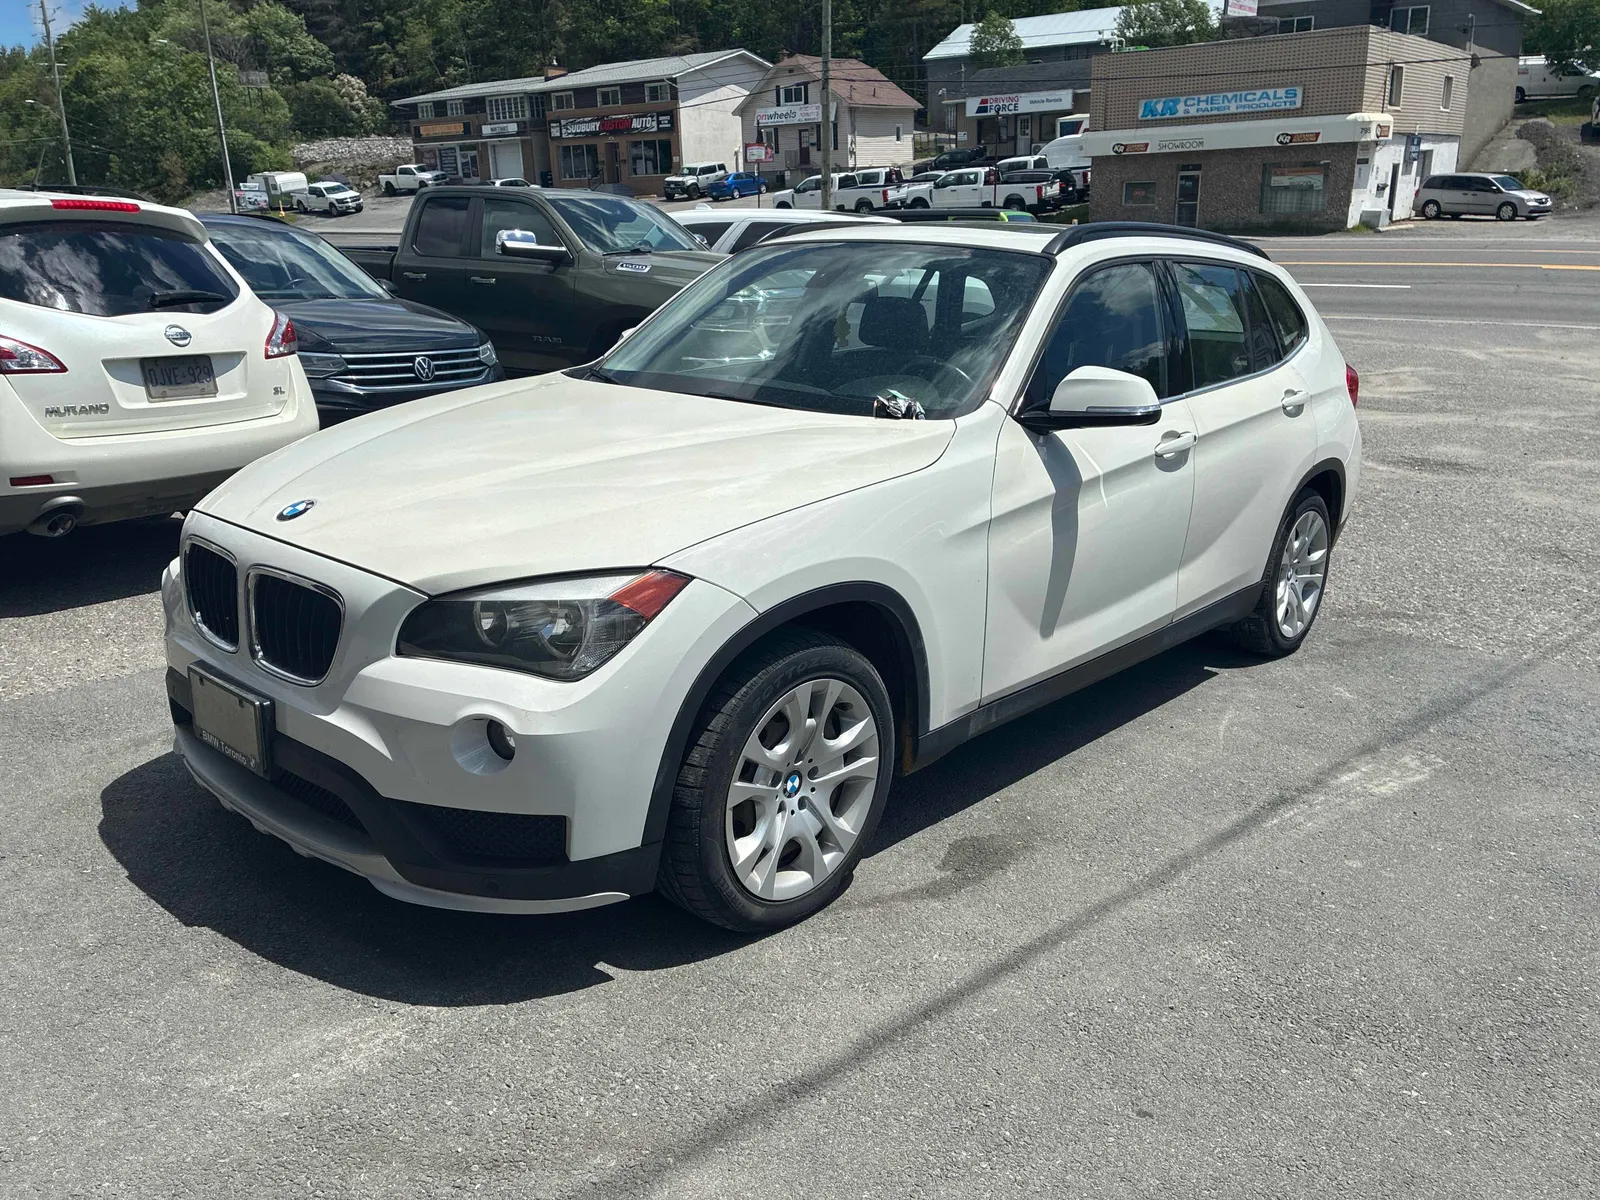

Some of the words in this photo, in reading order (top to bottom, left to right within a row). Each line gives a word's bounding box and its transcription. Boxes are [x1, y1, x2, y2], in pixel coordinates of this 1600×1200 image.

[989, 96, 1019, 104] DRIVING
[1140, 99, 1179, 118] KR
[1184, 88, 1298, 107] CHEMICALS
[989, 103, 1019, 112] FORCE
[1183, 107, 1190, 115] &
[1196, 105, 1231, 113] PAPER
[1236, 100, 1297, 111] PRODUCTS
[756, 110, 797, 121] onwheels
[567, 121, 600, 133] SUDBURY
[600, 118, 632, 131] CUSTOM
[631, 117, 652, 129] AUTO
[1158, 141, 1204, 151] SHOWROOM
[532, 335, 562, 343] RAM
[273, 387, 285, 396] SL
[45, 403, 109, 417] MURANO
[202, 730, 219, 748] BMW
[220, 741, 247, 765] Toronto
